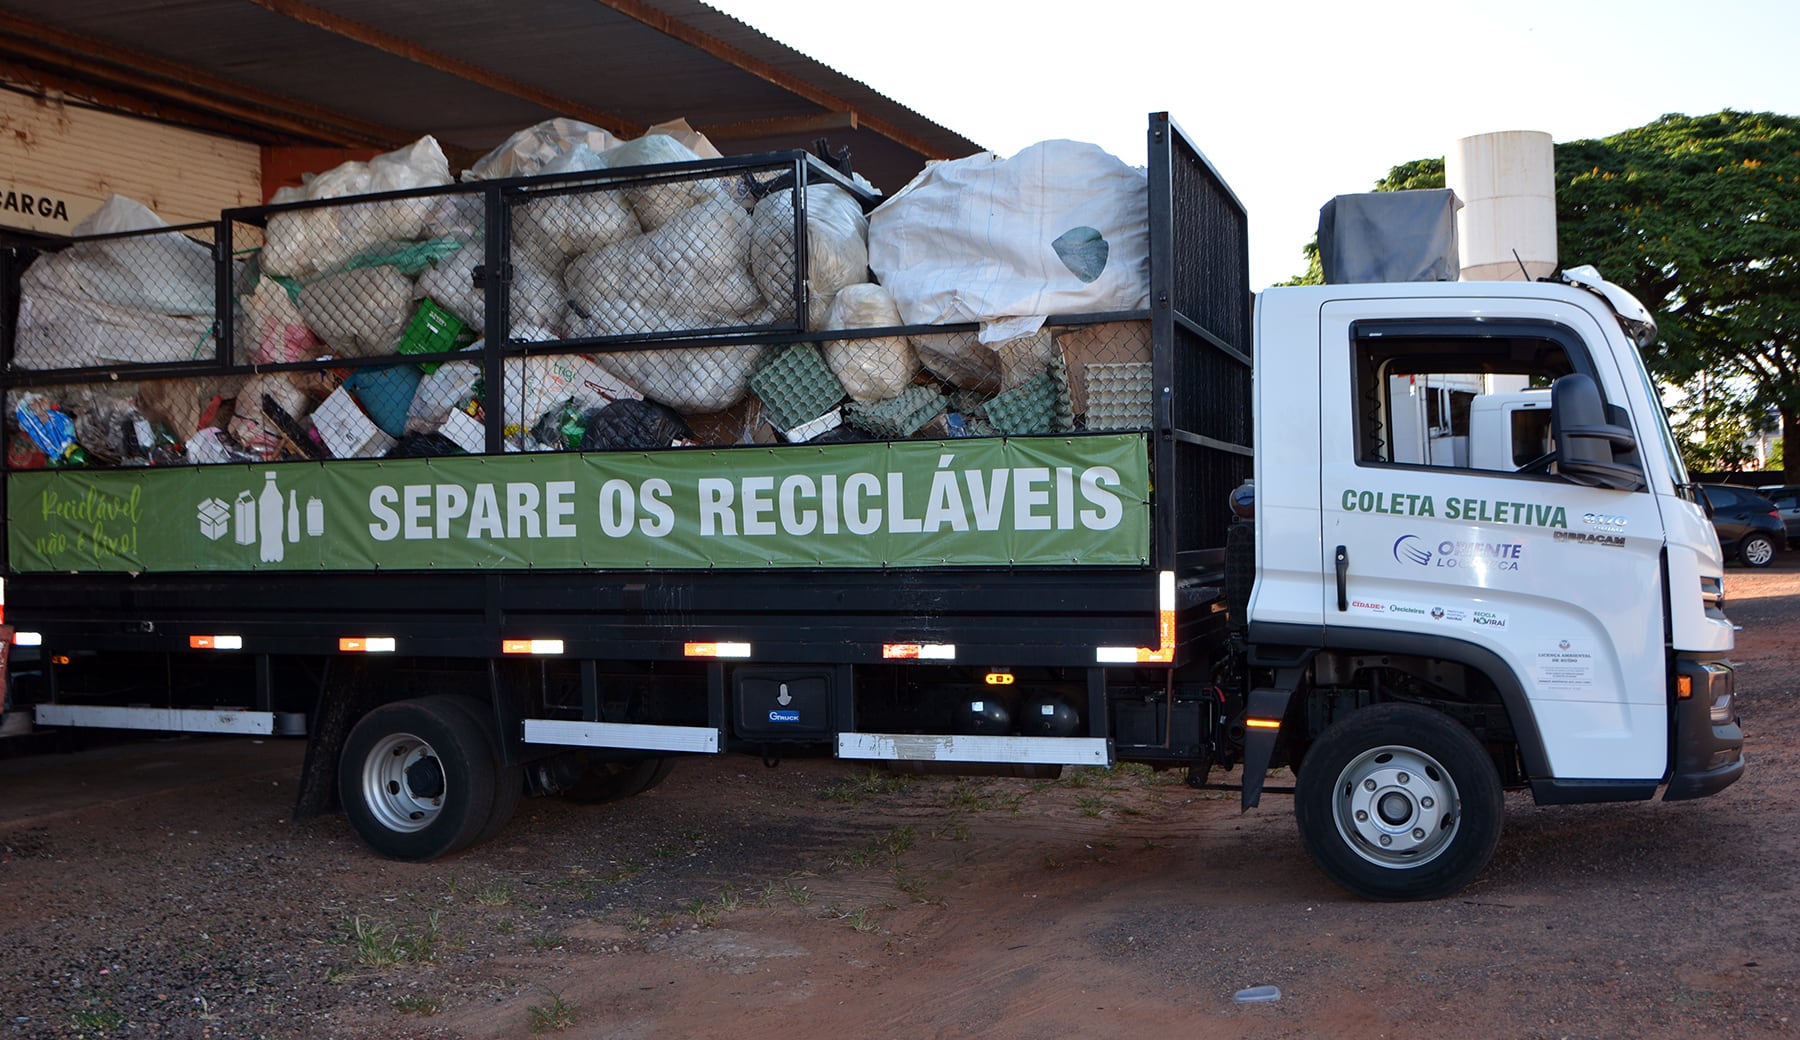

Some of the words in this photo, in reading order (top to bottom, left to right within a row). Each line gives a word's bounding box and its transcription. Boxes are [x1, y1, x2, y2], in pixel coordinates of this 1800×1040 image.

[0, 191, 69, 222] ARGA
[42, 484, 143, 523] Reciclável
[369, 481, 577, 541] SEPARE
[599, 478, 675, 540] OS
[699, 454, 1123, 537] RECICLÁVEIS
[1342, 489, 1435, 518] COLETA
[1445, 496, 1568, 529] SELETIVA
[1438, 541, 1522, 558] ORIENTE
